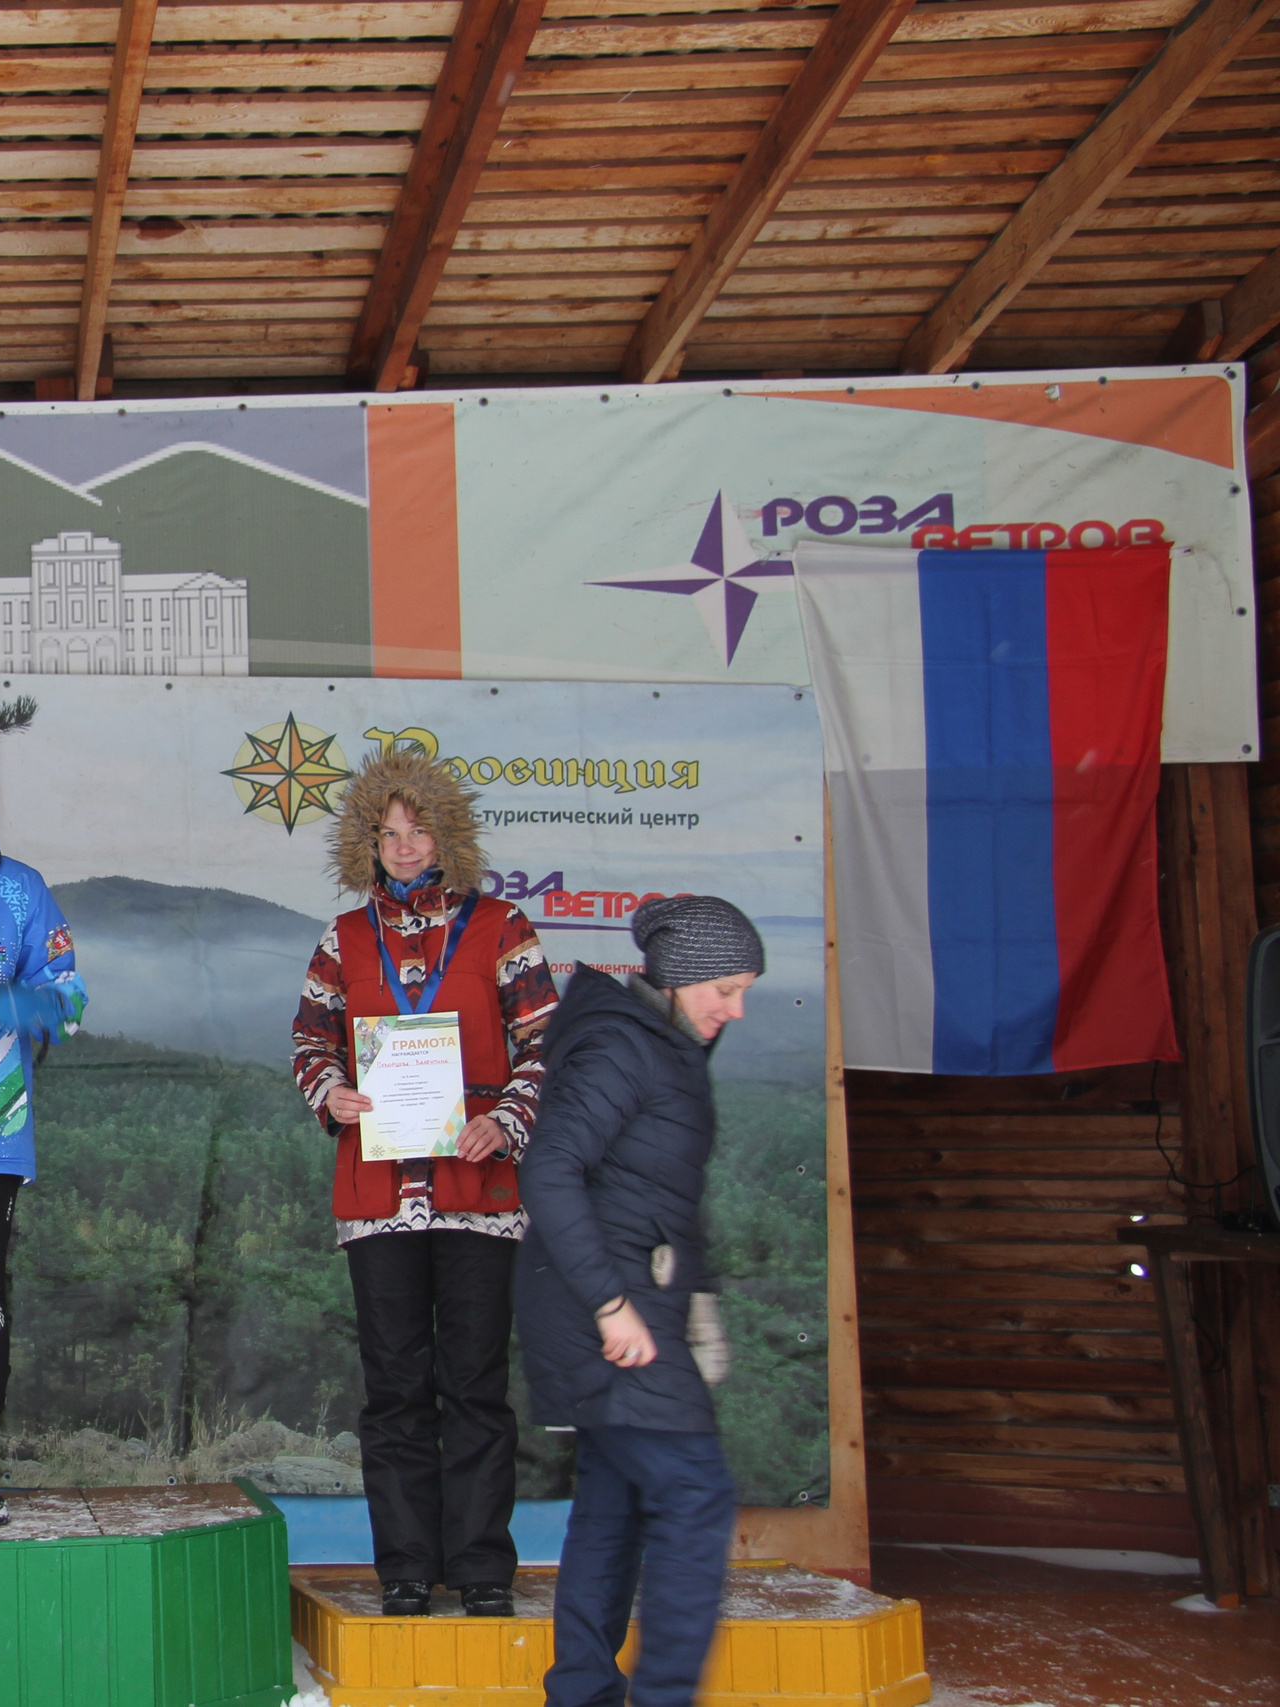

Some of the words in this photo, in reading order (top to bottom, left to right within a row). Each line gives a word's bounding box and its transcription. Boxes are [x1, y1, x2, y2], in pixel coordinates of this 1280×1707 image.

[762, 493, 955, 537] РОЗА
[639, 812, 700, 827] центр
[481, 870, 564, 900] ОЗА
[392, 1036, 456, 1051] ГРАМОТА
